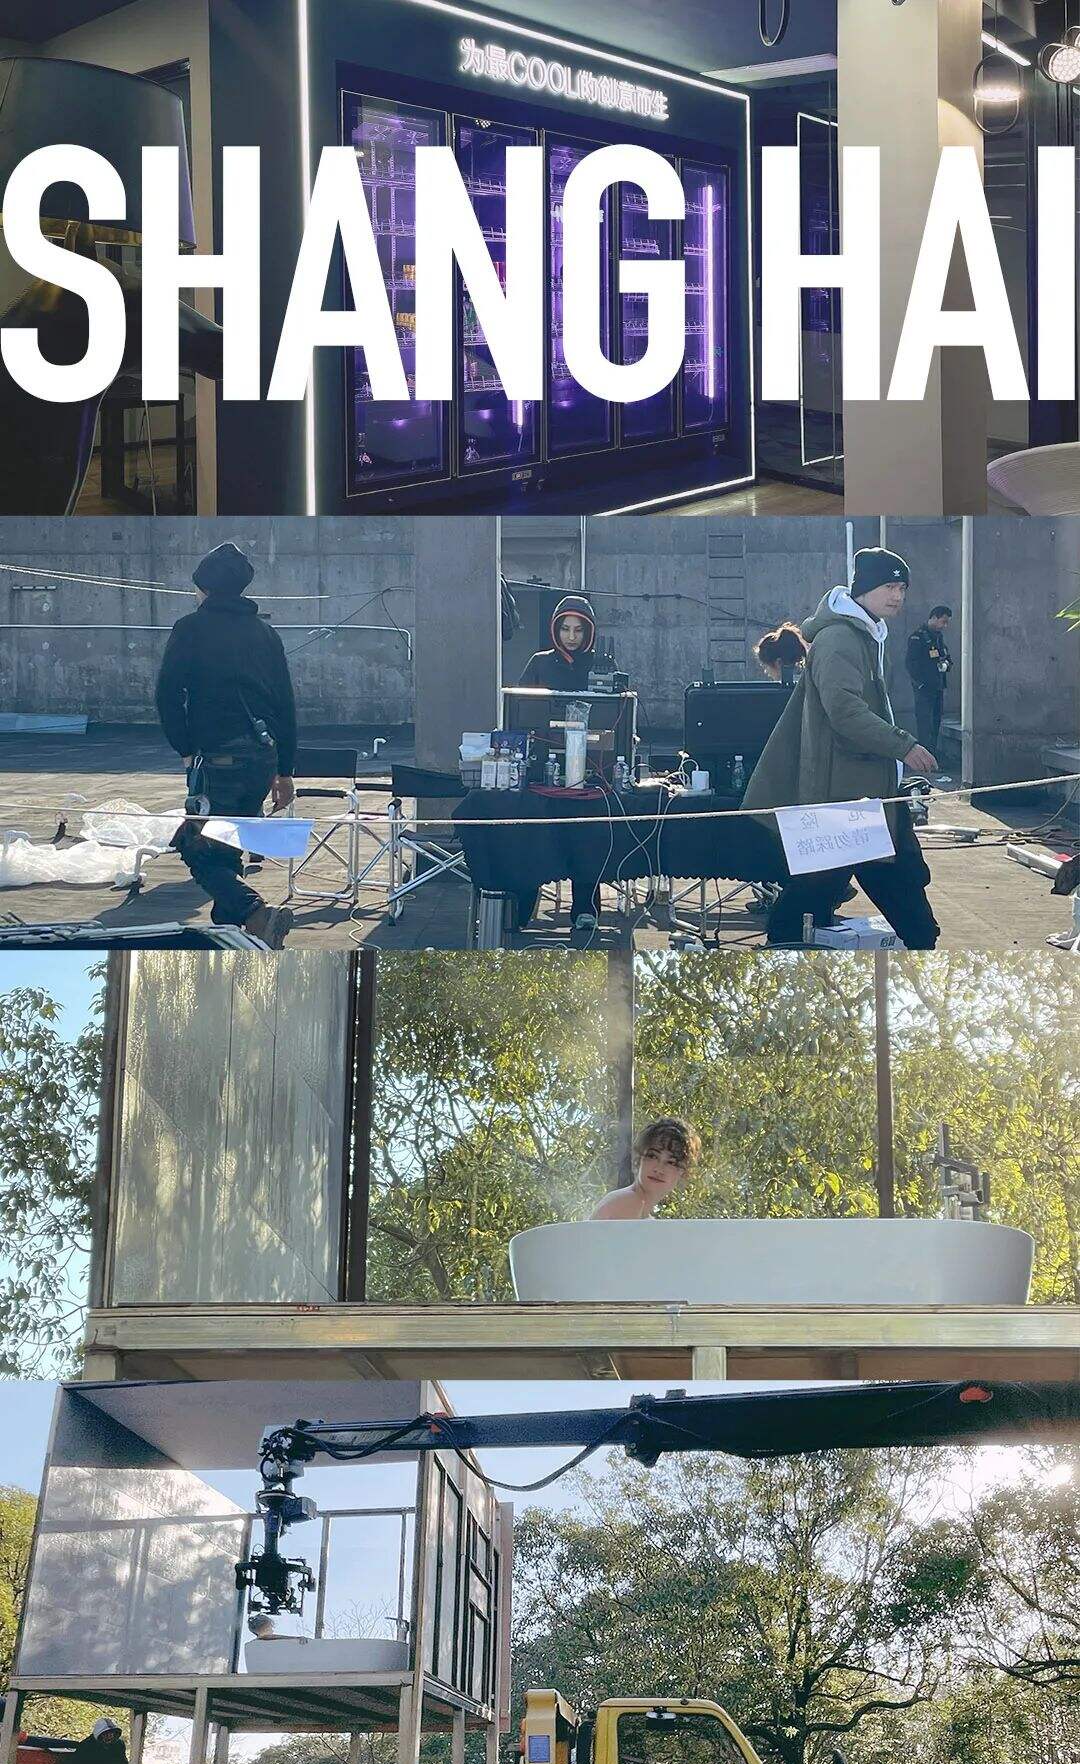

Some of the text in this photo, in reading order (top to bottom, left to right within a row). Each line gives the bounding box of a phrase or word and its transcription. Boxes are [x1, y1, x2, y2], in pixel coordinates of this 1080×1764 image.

[459, 37, 670, 121] 为最COOL的创意而生
